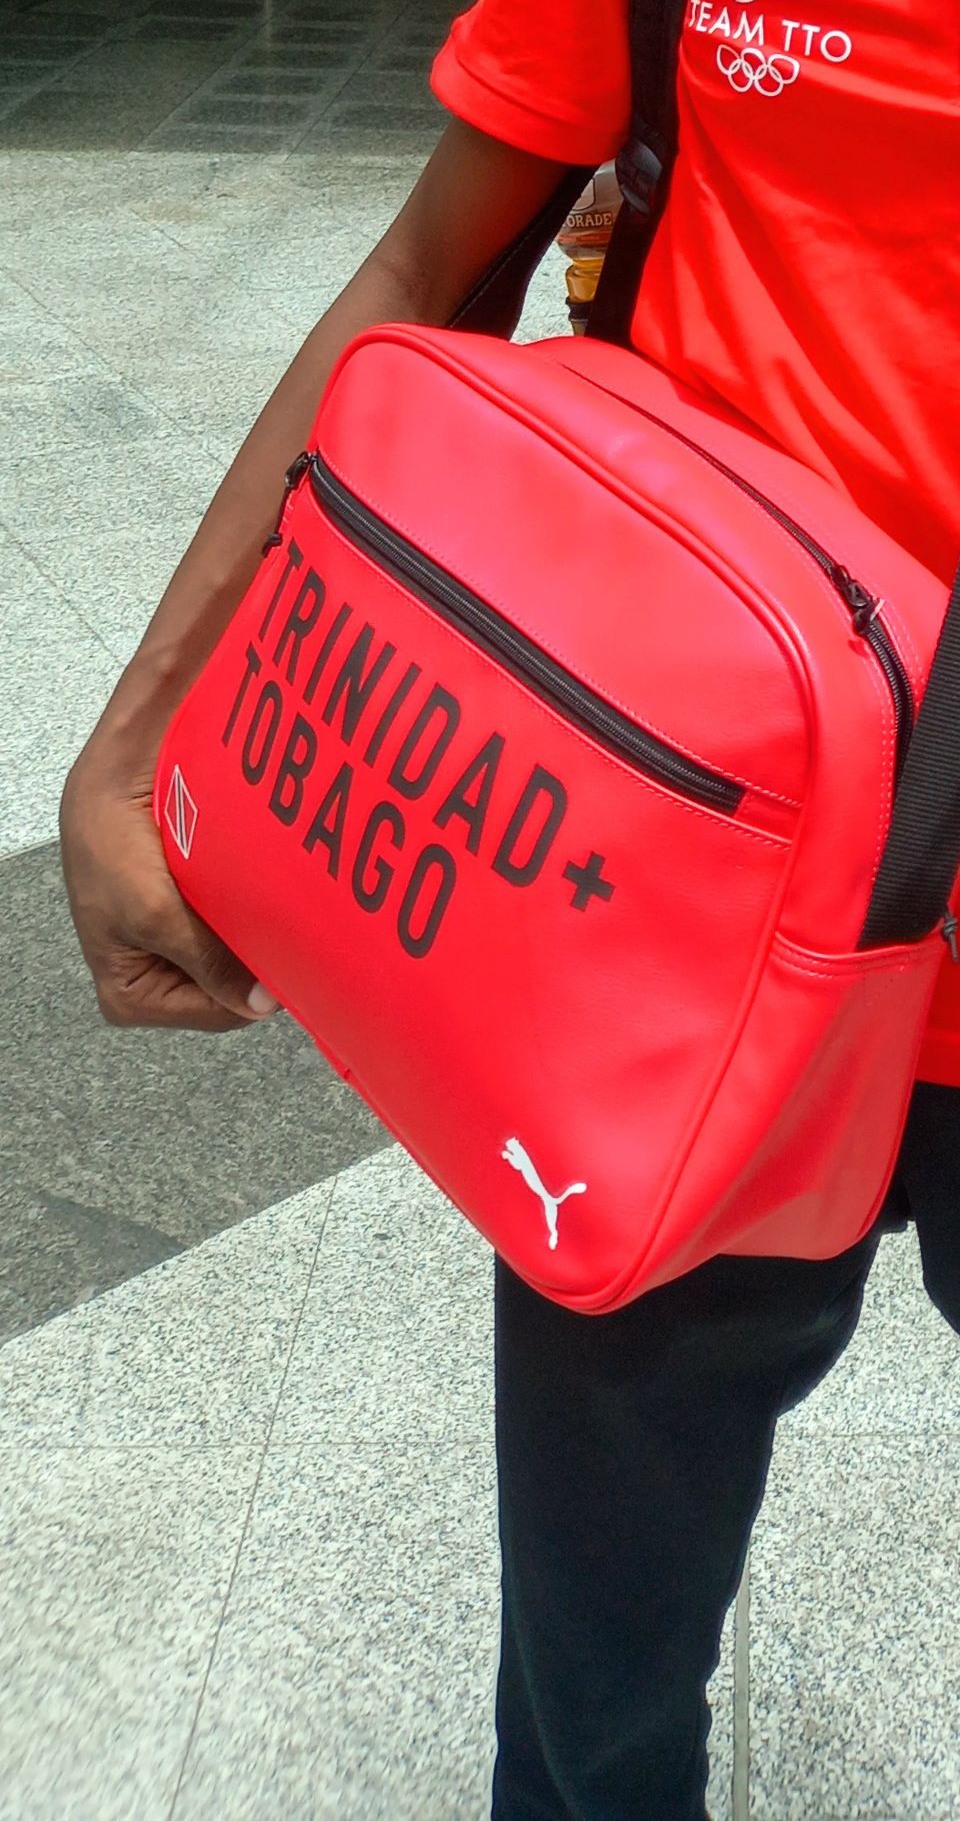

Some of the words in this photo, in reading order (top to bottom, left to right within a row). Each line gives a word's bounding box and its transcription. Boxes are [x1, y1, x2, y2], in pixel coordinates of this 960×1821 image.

[781, 19, 852, 63] TTO
[565, 212, 613, 228] ORADE
[221, 640, 458, 960] TOBAGO
